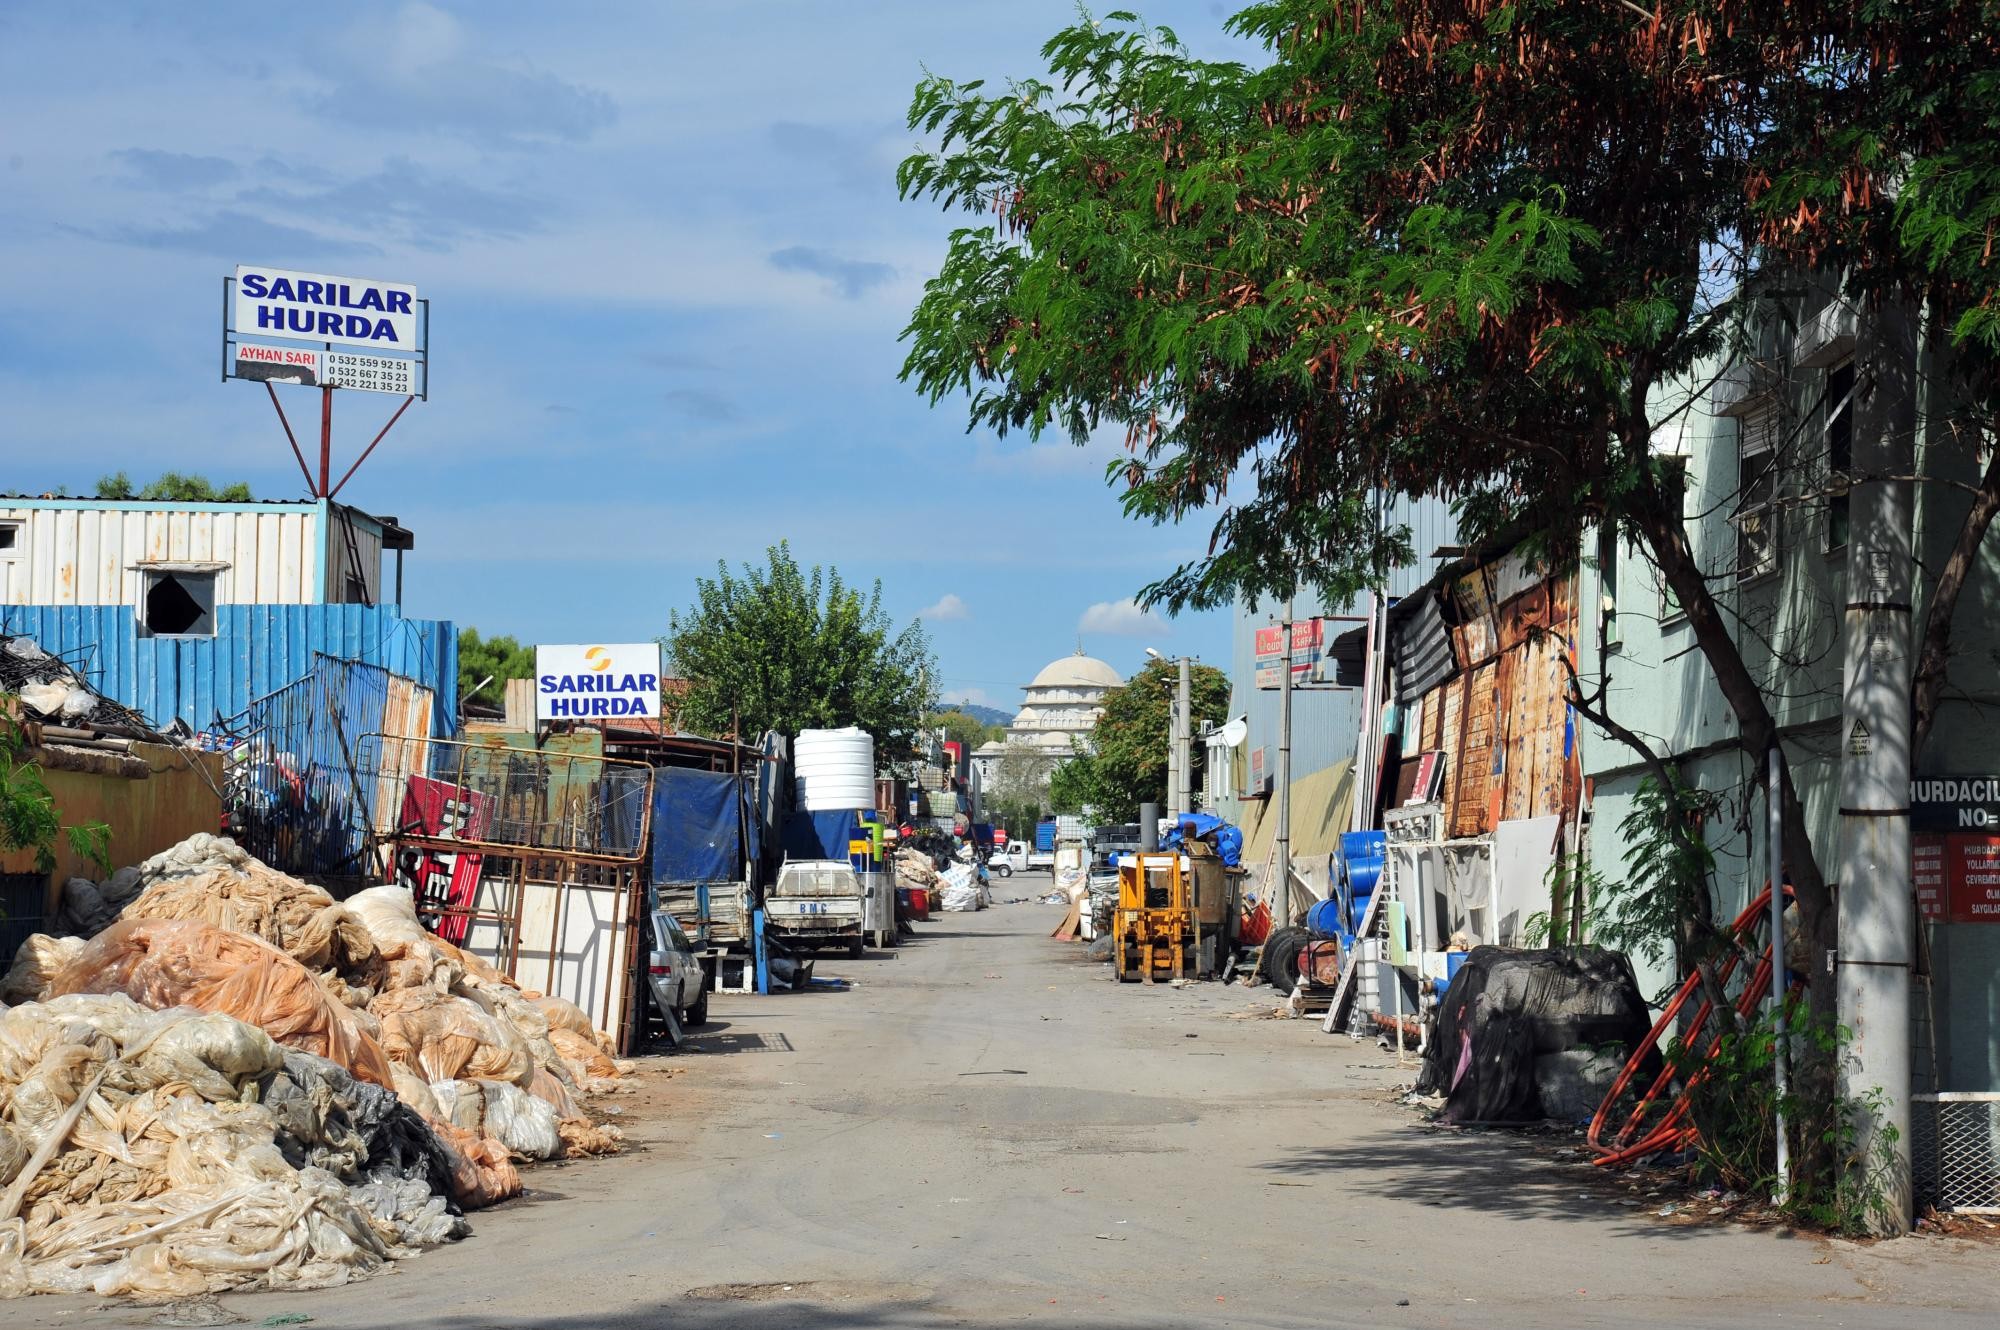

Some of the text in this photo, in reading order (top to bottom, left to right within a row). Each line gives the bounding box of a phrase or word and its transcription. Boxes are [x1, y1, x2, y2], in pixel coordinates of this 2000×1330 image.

[242, 274, 412, 315] SARILAR
[258, 305, 399, 342] HURDA
[240, 347, 315, 365] AYHAN SARI
[329, 354, 407, 371] 0 532 559 92 51
[329, 366, 408, 382] 0 532 667 35 23
[338, 378, 357, 388] 242
[359, 380, 377, 390] 221
[380, 382, 393, 391] 35
[395, 383, 408, 393] 23
[540, 674, 657, 693] SARILAR
[551, 697, 648, 716] HURDA
